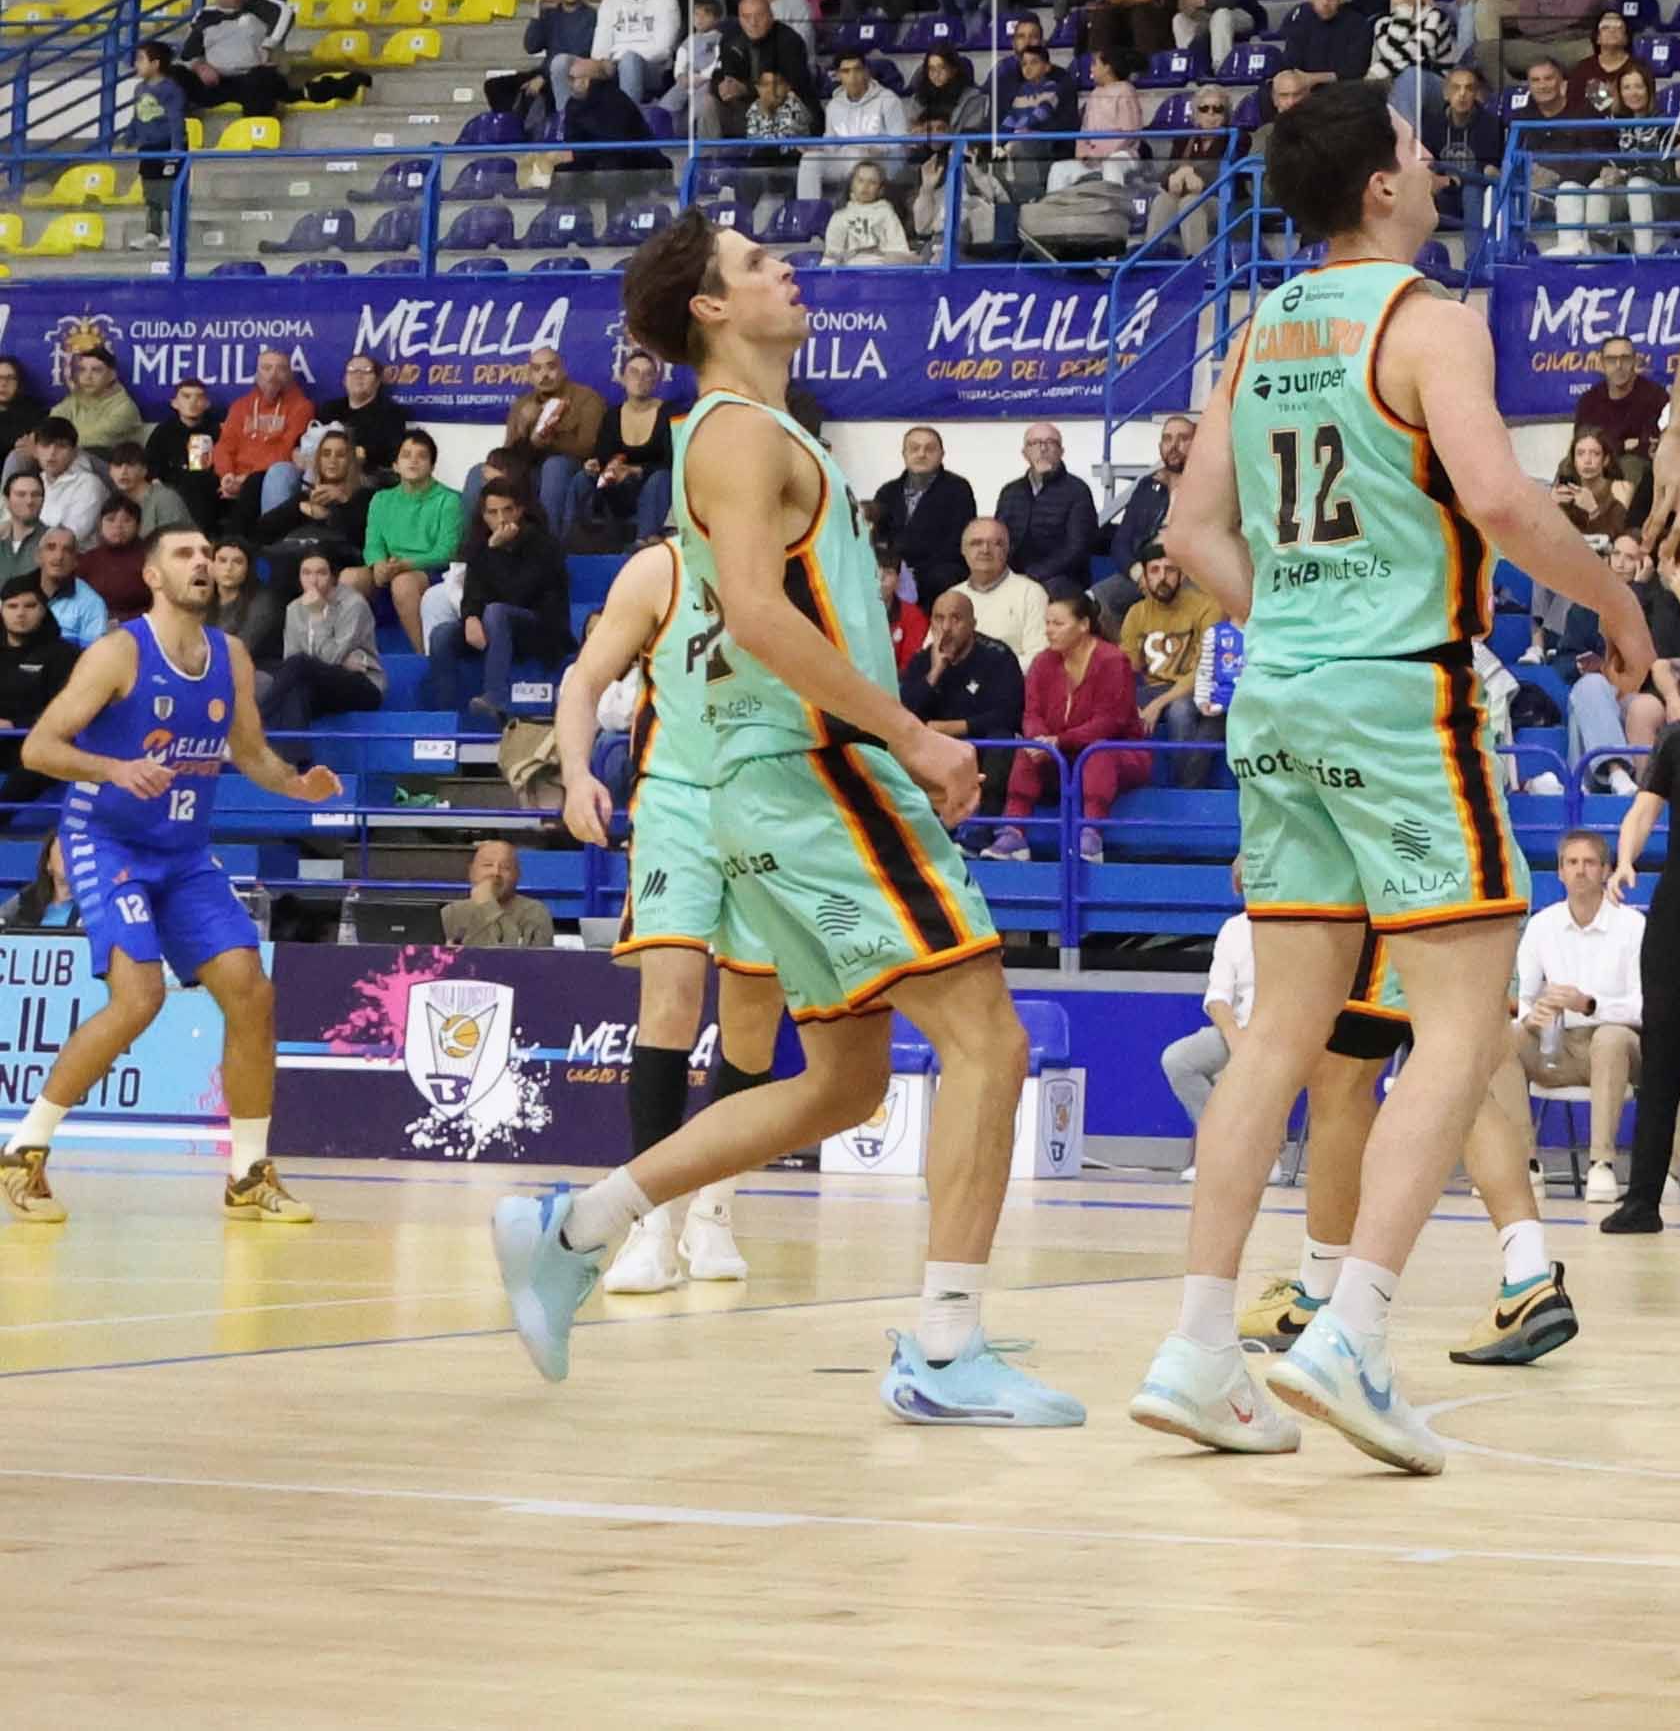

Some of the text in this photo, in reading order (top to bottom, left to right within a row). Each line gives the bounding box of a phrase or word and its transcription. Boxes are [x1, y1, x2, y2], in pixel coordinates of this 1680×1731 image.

[130, 317, 314, 339] CIUDAD AUTÓNOMA
[353, 297, 569, 361] MELILLA
[926, 359, 1002, 382] CIUDAD
[1011, 357, 1050, 380] DEL
[1269, 424, 1361, 548] 12
[168, 789, 197, 821] 12
[1381, 870, 1462, 897] ALUA
[114, 893, 149, 925] 12
